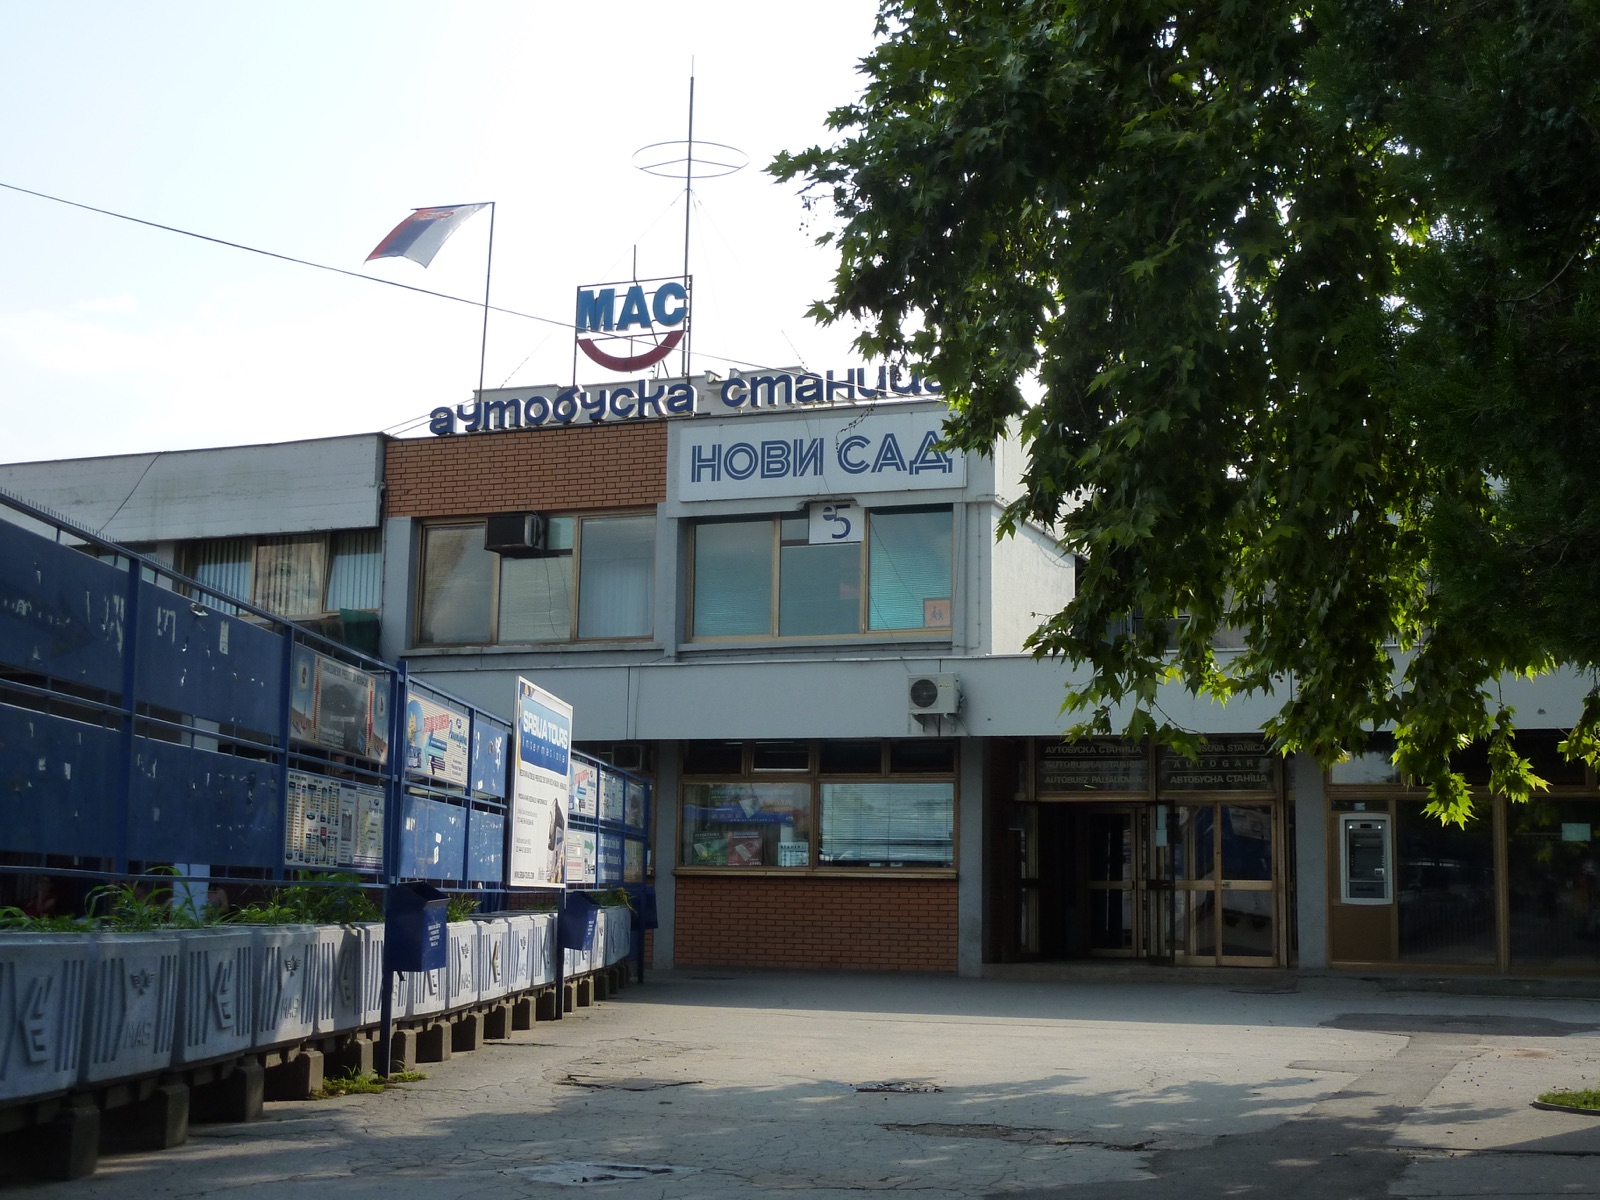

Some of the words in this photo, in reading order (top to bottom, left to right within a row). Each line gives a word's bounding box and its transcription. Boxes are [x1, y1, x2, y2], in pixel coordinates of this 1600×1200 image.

[577, 282, 689, 333] МАС
[429, 379, 698, 435] аутобуска
[690, 437, 824, 483] НОВИ
[837, 430, 954, 476] САД
[1045, 745, 1097, 754] АУТОБУСКА
[1098, 745, 1143, 754] СТАНИЦА
[1166, 743, 1226, 753] ASOVA
[1227, 743, 1266, 752] STANICA
[1044, 776, 1090, 784] AUTOBUSZ
[1170, 775, 1224, 784] АВТОБУСНА
